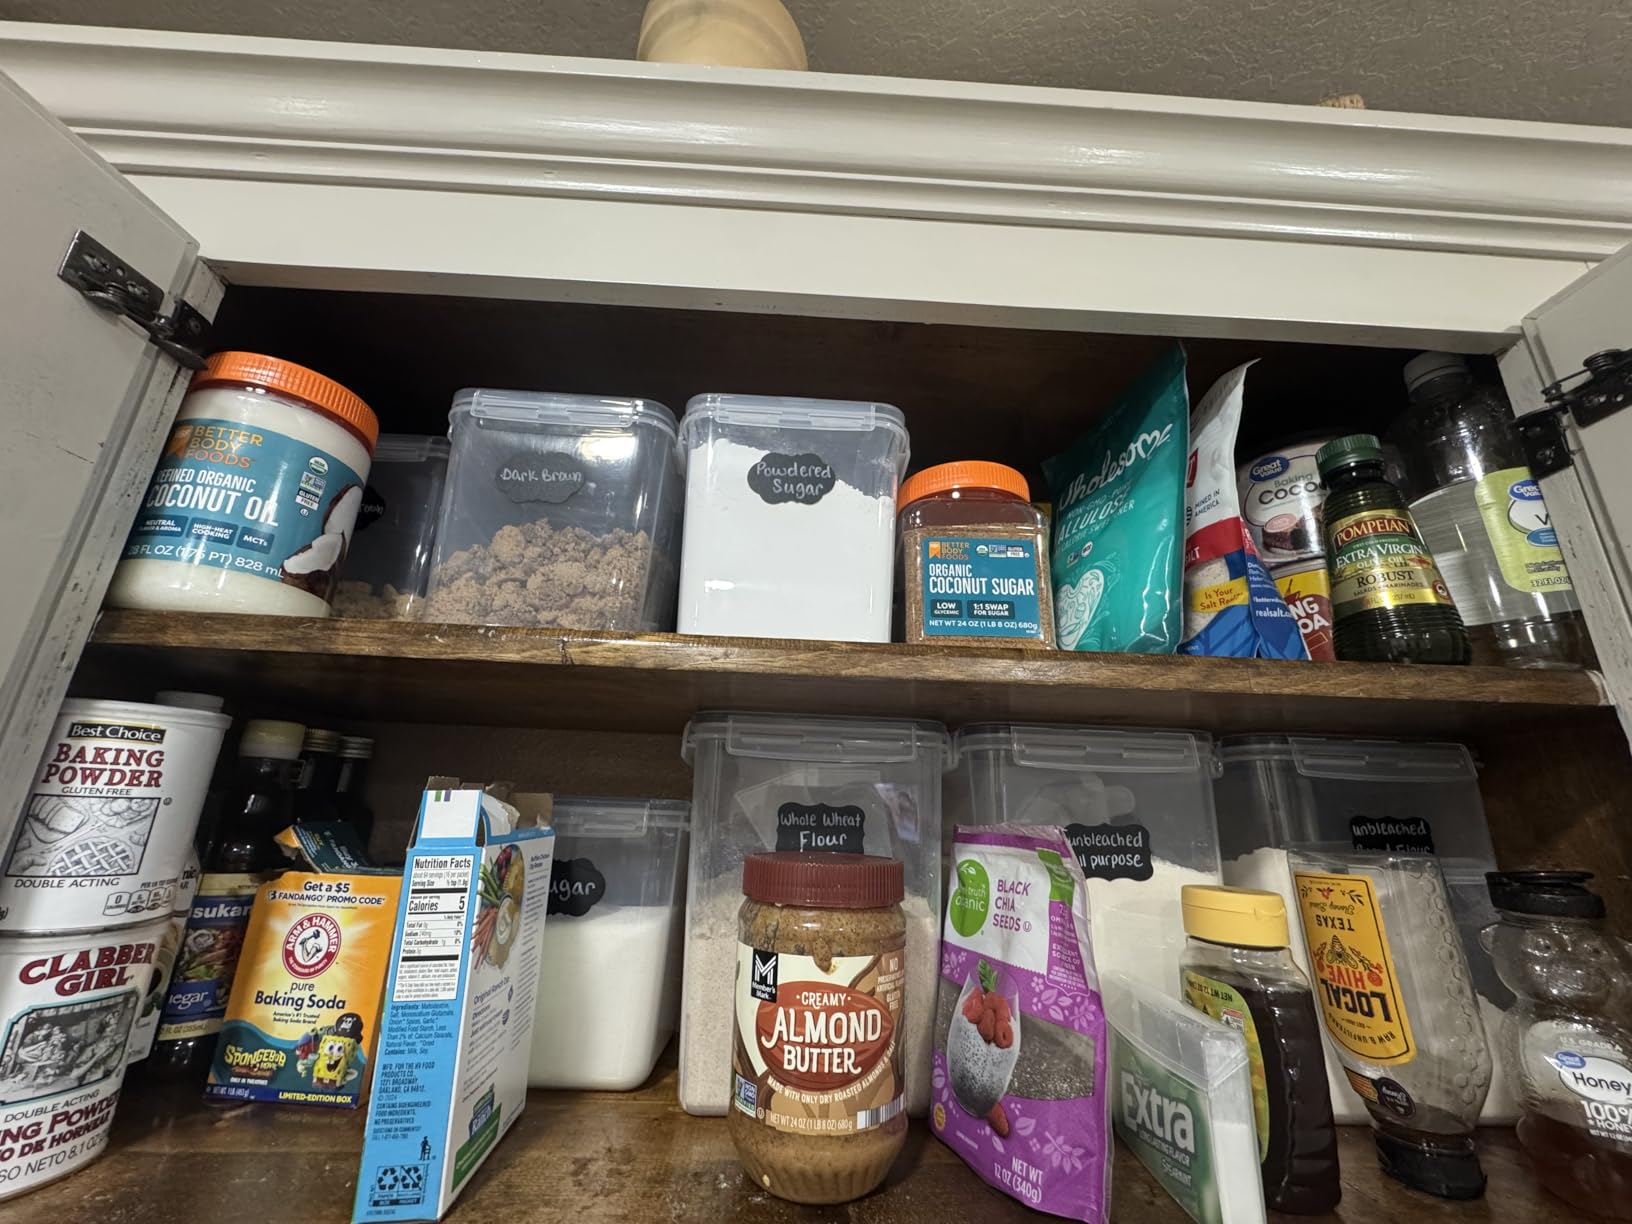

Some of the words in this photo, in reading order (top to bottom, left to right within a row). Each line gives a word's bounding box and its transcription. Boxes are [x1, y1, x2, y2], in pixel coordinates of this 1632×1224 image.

[190, 437, 241, 452] BODY
[195, 425, 263, 446] BETTER
[187, 450, 250, 469] FOODS
[1252, 460, 1281, 475] Great
[500, 468, 538, 481] Dark
[757, 461, 831, 479] Powdered
[197, 469, 256, 494] ORGANIC
[773, 478, 824, 499] Sugar
[1274, 473, 1313, 488] Baking
[146, 485, 242, 515] COCONUT
[244, 496, 278, 527] OIL
[1194, 494, 1212, 509] MINED
[1213, 488, 1221, 498] IN
[1194, 501, 1220, 517] AMERICA
[192, 529, 229, 539] COOKING
[193, 523, 234, 535] HIGH-HEAT
[1336, 519, 1410, 546] POMPEIAN
[243, 535, 268, 546] MCTs
[141, 545, 151, 554] FL
[155, 545, 174, 555] OZ
[208, 551, 232, 568] PT)
[235, 557, 263, 571] 828
[265, 566, 284, 578] mL
[1336, 547, 1377, 569] EXTRA
[1376, 543, 1423, 555] VIRGIN
[929, 564, 972, 577] ORGANIC
[1356, 571, 1414, 588] ROBUST
[929, 577, 987, 594] COCONUT
[992, 578, 1034, 596] SUGAR
[1205, 592, 1212, 600] Is
[1213, 588, 1232, 596] Your
[1200, 600, 1217, 610] Salt
[1018, 622, 1038, 630] 680g
[71, 724, 102, 736] Best
[106, 726, 161, 742] Choice
[53, 743, 165, 767] BAKING
[41, 764, 163, 788] POWDER
[61, 786, 104, 795] GLUTEN
[780, 812, 816, 826] Whole
[823, 812, 861, 827] Wheat
[1352, 820, 1427, 836] unbleached
[800, 831, 847, 853] Flour
[414, 858, 448, 868] Nutrition
[450, 858, 471, 868] Facts
[1090, 854, 1143, 870] purpose
[14, 879, 65, 888] DOUBLE
[68, 877, 120, 888] ACTING
[304, 881, 323, 893] Get
[325, 885, 332, 893] a
[336, 883, 350, 893] $5
[550, 879, 596, 901] ugar
[997, 880, 1031, 896] BLACK
[278, 893, 325, 902] FANDANGO
[327, 896, 356, 904] PROMO
[409, 900, 438, 911] Calories
[458, 896, 465, 910] 5
[995, 897, 1015, 912] CHIA
[992, 914, 1021, 932] SEEDS
[1315, 914, 1355, 932] TEXAS
[286, 925, 303, 950] ARM
[303, 920, 310, 929] &
[312, 916, 338, 953] HAMMER
[55, 968, 130, 997] GIRL
[290, 981, 315, 993] pure
[1326, 965, 1367, 991] HIVE
[752, 981, 776, 994] Member's
[255, 990, 305, 1011] Baking
[307, 994, 346, 1009] Soda
[801, 991, 847, 1009] CREAMY
[1320, 978, 1393, 1023] LOCAL
[761, 1007, 882, 1048] ALMOND
[1377, 1031, 1396, 1043] RAW
[783, 1045, 862, 1075] BUTTER
[767, 1075, 784, 1095] MADE
[784, 1088, 800, 1101] WITH
[802, 1094, 818, 1104] ONLY
[819, 1096, 832, 1104] DRY
[834, 1081, 862, 1102] ROASTED
[862, 1065, 885, 1090] ALMONDS
[1572, 1072, 1632, 1095] Honey
[4, 1103, 60, 1122] DOUBLE
[61, 1089, 100, 1108] ACTING
[279, 1092, 336, 1102] LIMITED-EDITION
[336, 1095, 352, 1103] BOX
[1120, 1071, 1196, 1152] Extra
[790, 1116, 798, 1128] 24
[798, 1116, 807, 1128] OZ
[837, 1120, 853, 1130] 680g
[18, 1137, 47, 1158] DE
[25, 1151, 67, 1176] NETO
[1012, 1157, 1027, 1176] NET
[1029, 1167, 1044, 1186] WT
[994, 1162, 1001, 1177] 12
[1002, 1171, 1011, 1187] OZ
[1012, 1175, 1041, 1203] (340g)
